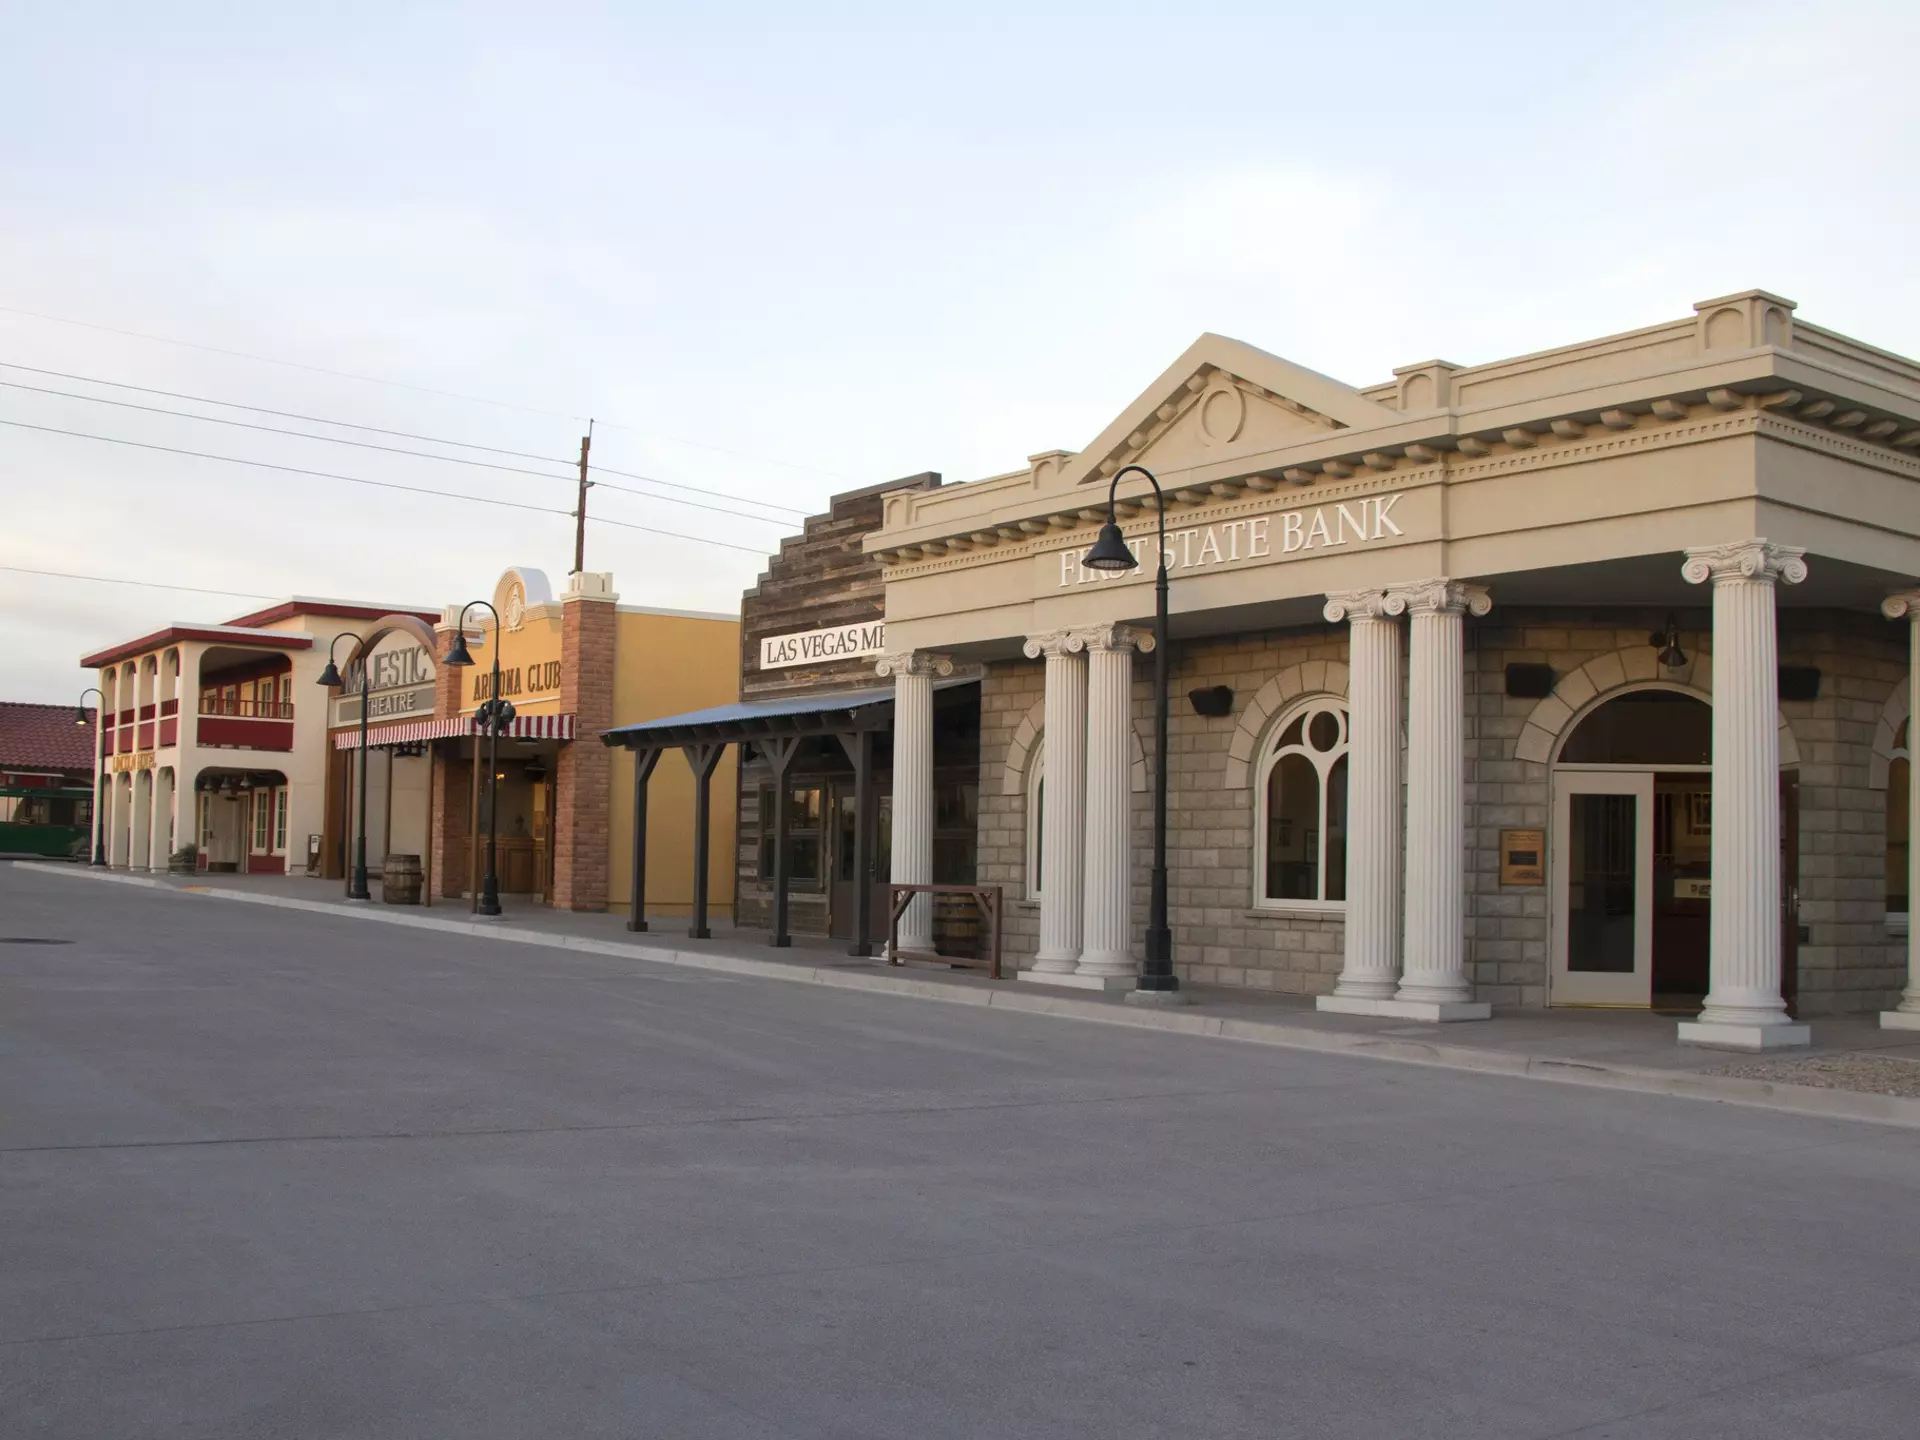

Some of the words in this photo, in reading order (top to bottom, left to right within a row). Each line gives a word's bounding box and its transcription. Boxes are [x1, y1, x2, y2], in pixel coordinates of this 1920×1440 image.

[1157, 517, 1271, 572] STATE
[1282, 494, 1404, 553] BANK
[766, 638, 797, 664] LAS
[800, 629, 858, 659] VEGAS
[473, 667, 522, 701] ARIONA
[527, 660, 561, 693] CLUB
[367, 692, 416, 717] THEATRE
